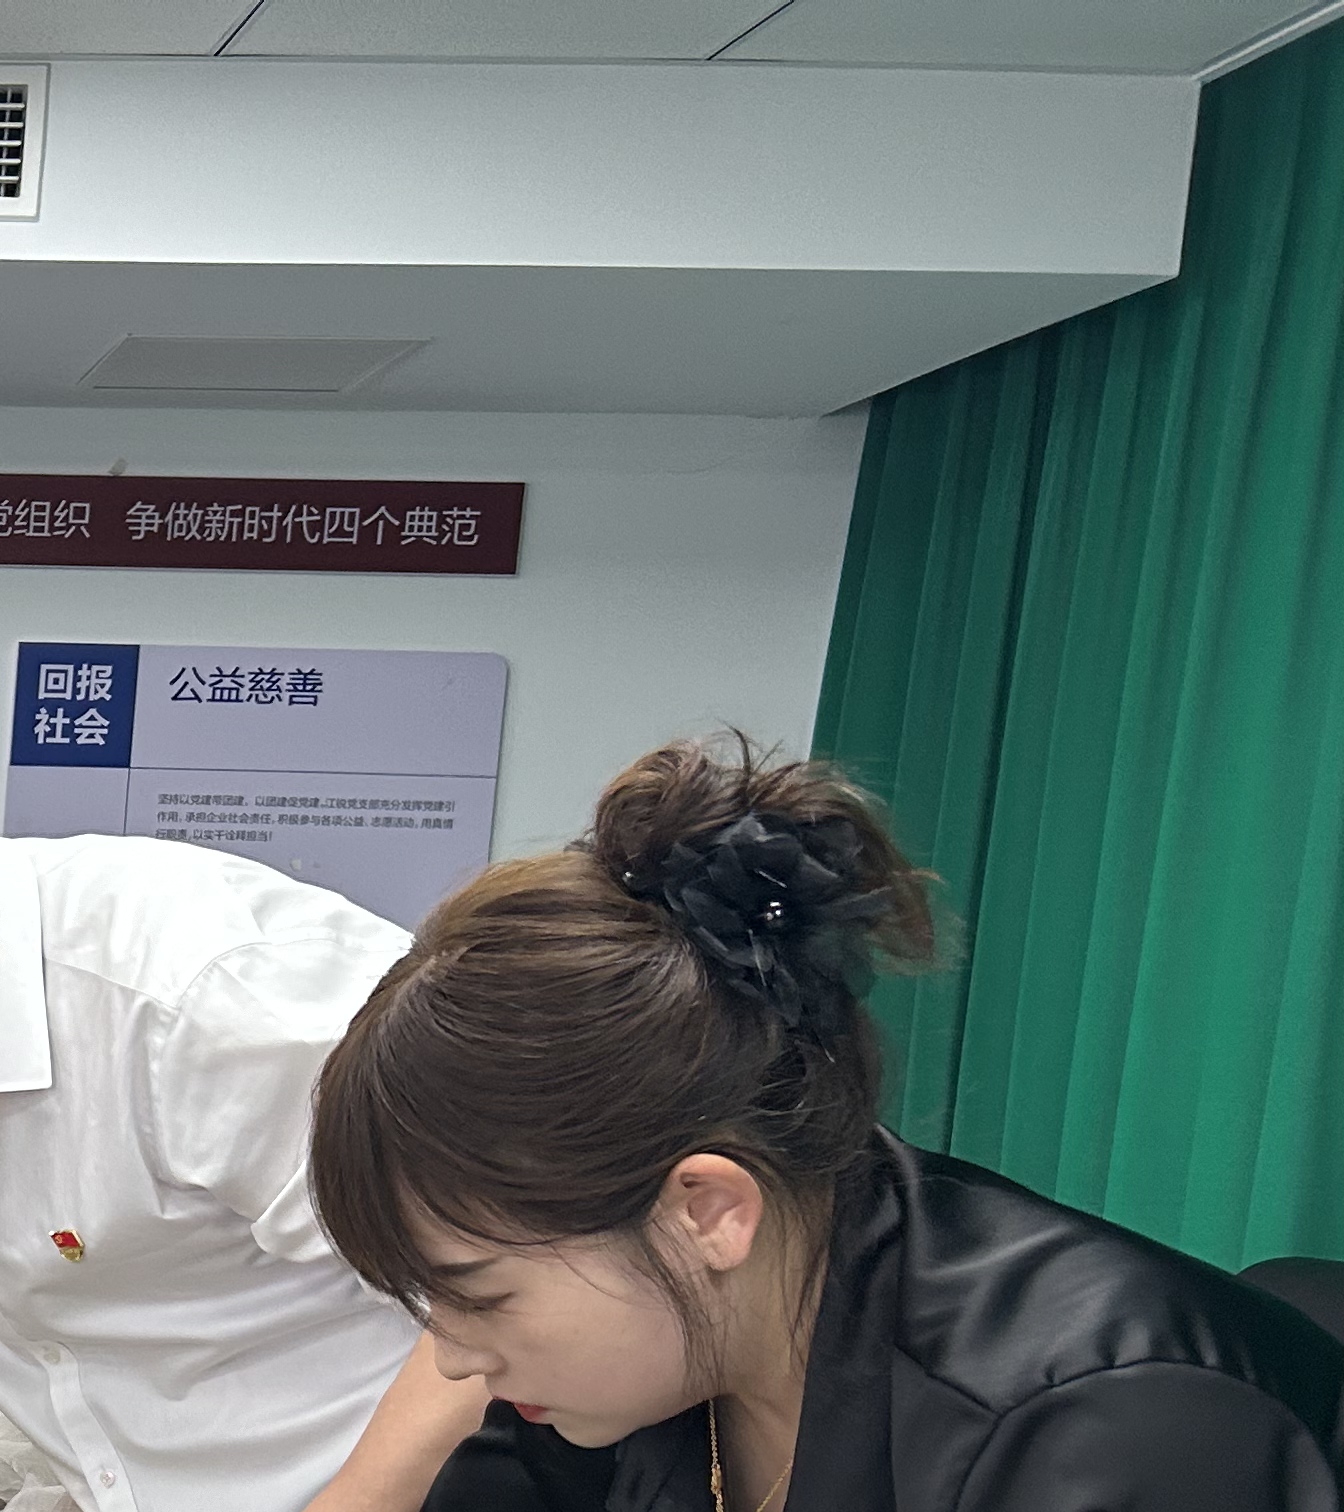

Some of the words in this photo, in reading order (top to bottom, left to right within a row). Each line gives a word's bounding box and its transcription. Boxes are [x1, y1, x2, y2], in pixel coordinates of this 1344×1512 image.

[124, 500, 482, 547] 争做新时代四个典范
[38, 663, 113, 703] 回报
[168, 666, 325, 707] 公益慈善
[34, 707, 111, 746] 社会
